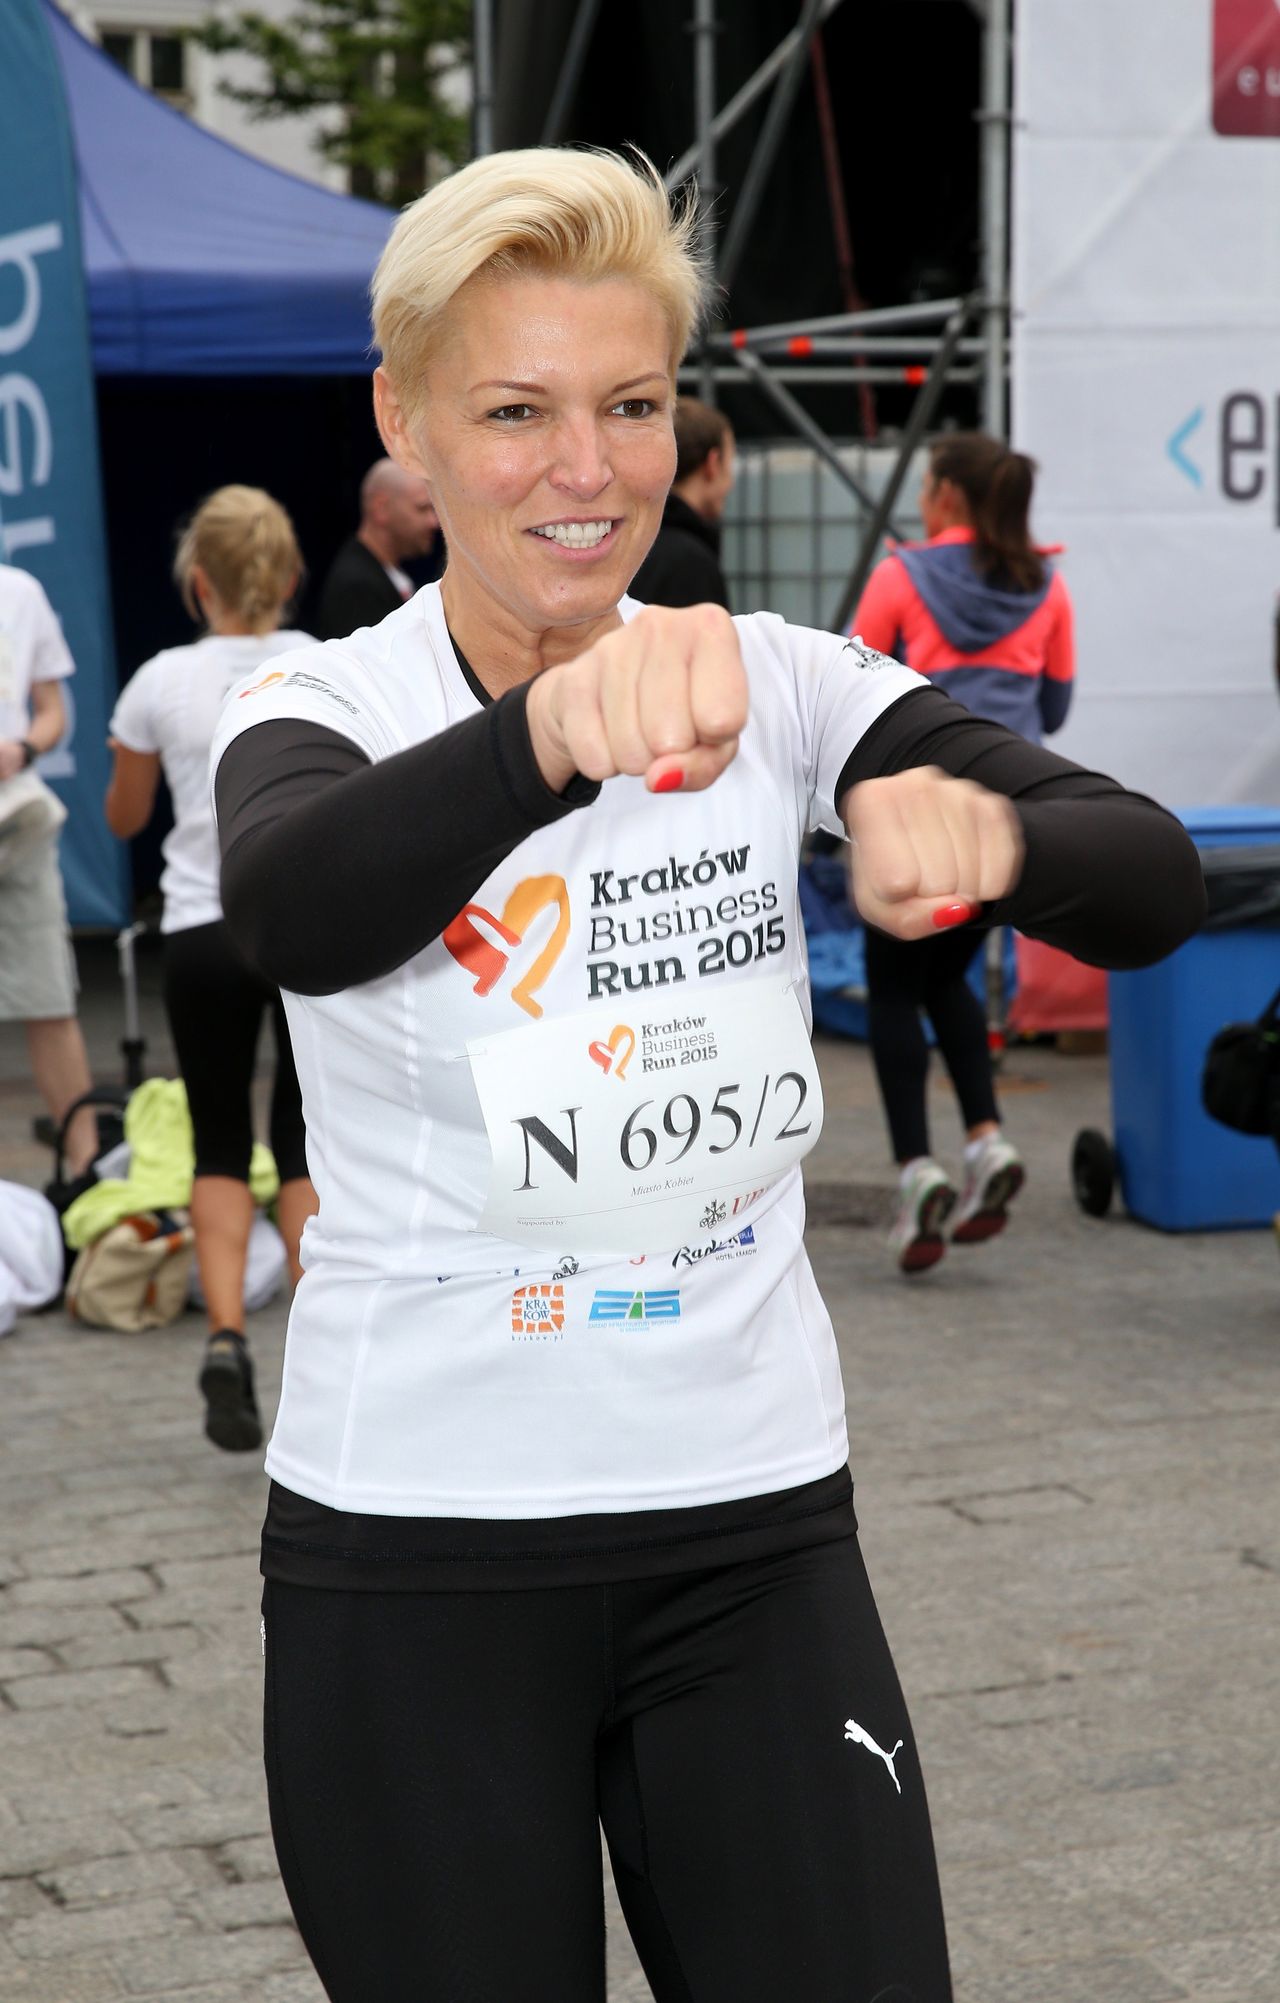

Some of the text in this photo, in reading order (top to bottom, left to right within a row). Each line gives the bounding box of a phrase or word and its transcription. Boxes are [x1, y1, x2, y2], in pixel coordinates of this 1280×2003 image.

[589, 844, 751, 909] Kraków
[587, 881, 778, 956] Business
[586, 914, 787, 1001] Run 2015
[641, 1016, 708, 1039] Kraków
[642, 1031, 716, 1057] Business
[642, 1044, 719, 1074] Run 2015
[511, 1070, 813, 1192] N 695/2
[630, 1174, 696, 1197] Miasto Kobiet
[525, 1299, 548, 1310] KRA
